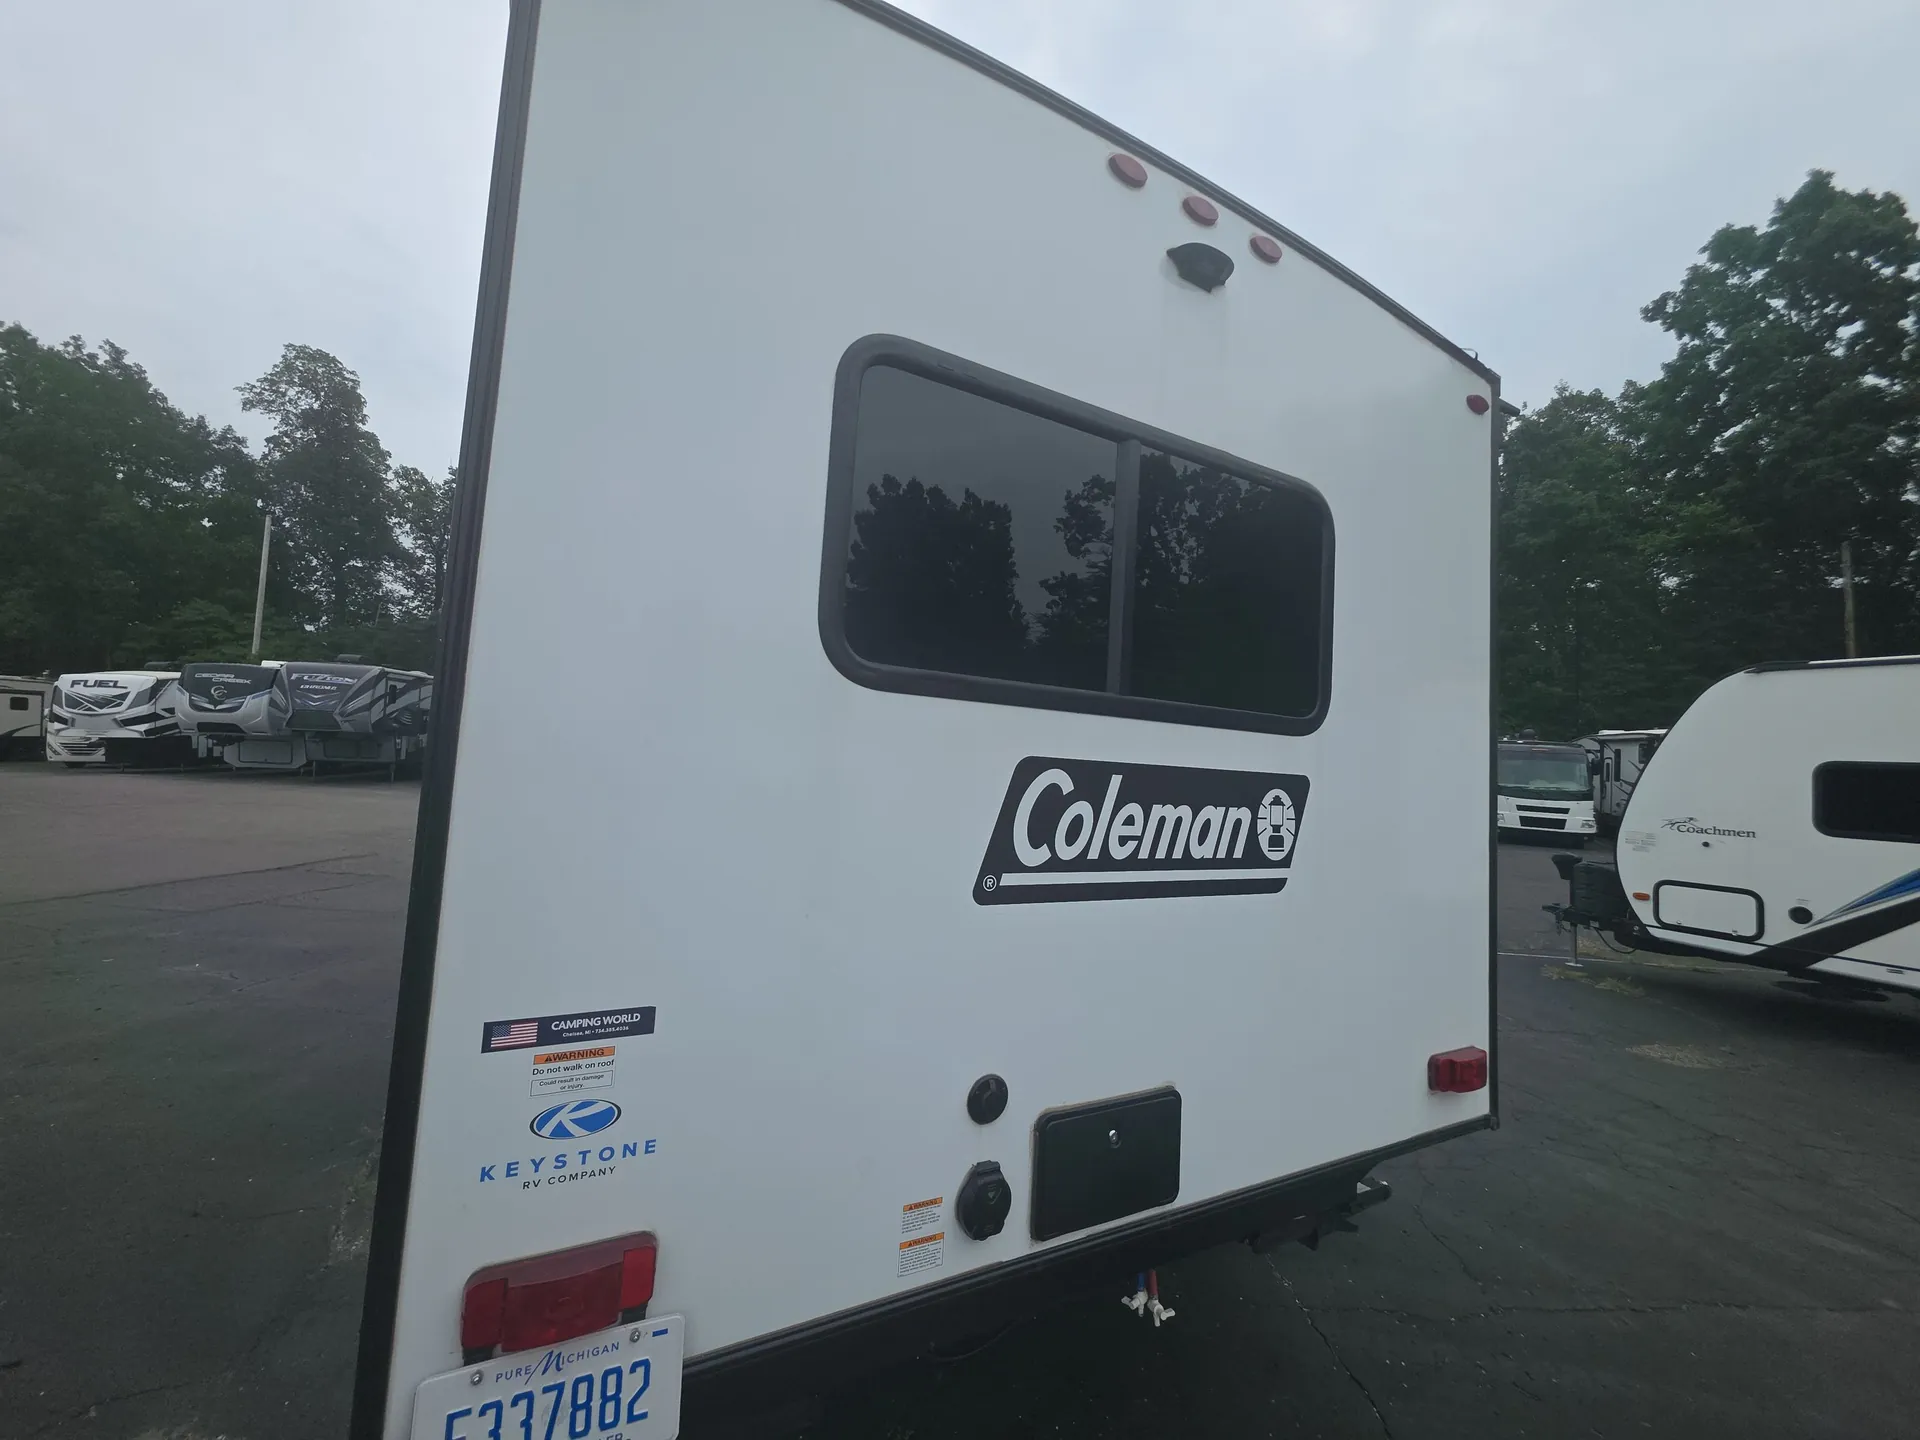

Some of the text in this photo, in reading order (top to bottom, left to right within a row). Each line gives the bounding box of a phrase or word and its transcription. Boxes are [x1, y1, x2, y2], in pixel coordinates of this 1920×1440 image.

[70, 680, 128, 688] FUEL
[1013, 768, 1251, 867] Coleman
[1676, 824, 1756, 838] Coachmen
[551, 1013, 640, 1031] CAMPING WORLD
[552, 1048, 604, 1061] WARNING
[532, 1067, 544, 1075] Do
[547, 1066, 561, 1074] not
[563, 1063, 583, 1071] walk
[597, 1059, 614, 1067] roof
[581, 1073, 604, 1081] damage
[480, 1139, 656, 1182] KEYSTONE
[522, 1166, 616, 1190] RV COMPANY
[495, 1341, 620, 1385] PURE MICHIGAN
